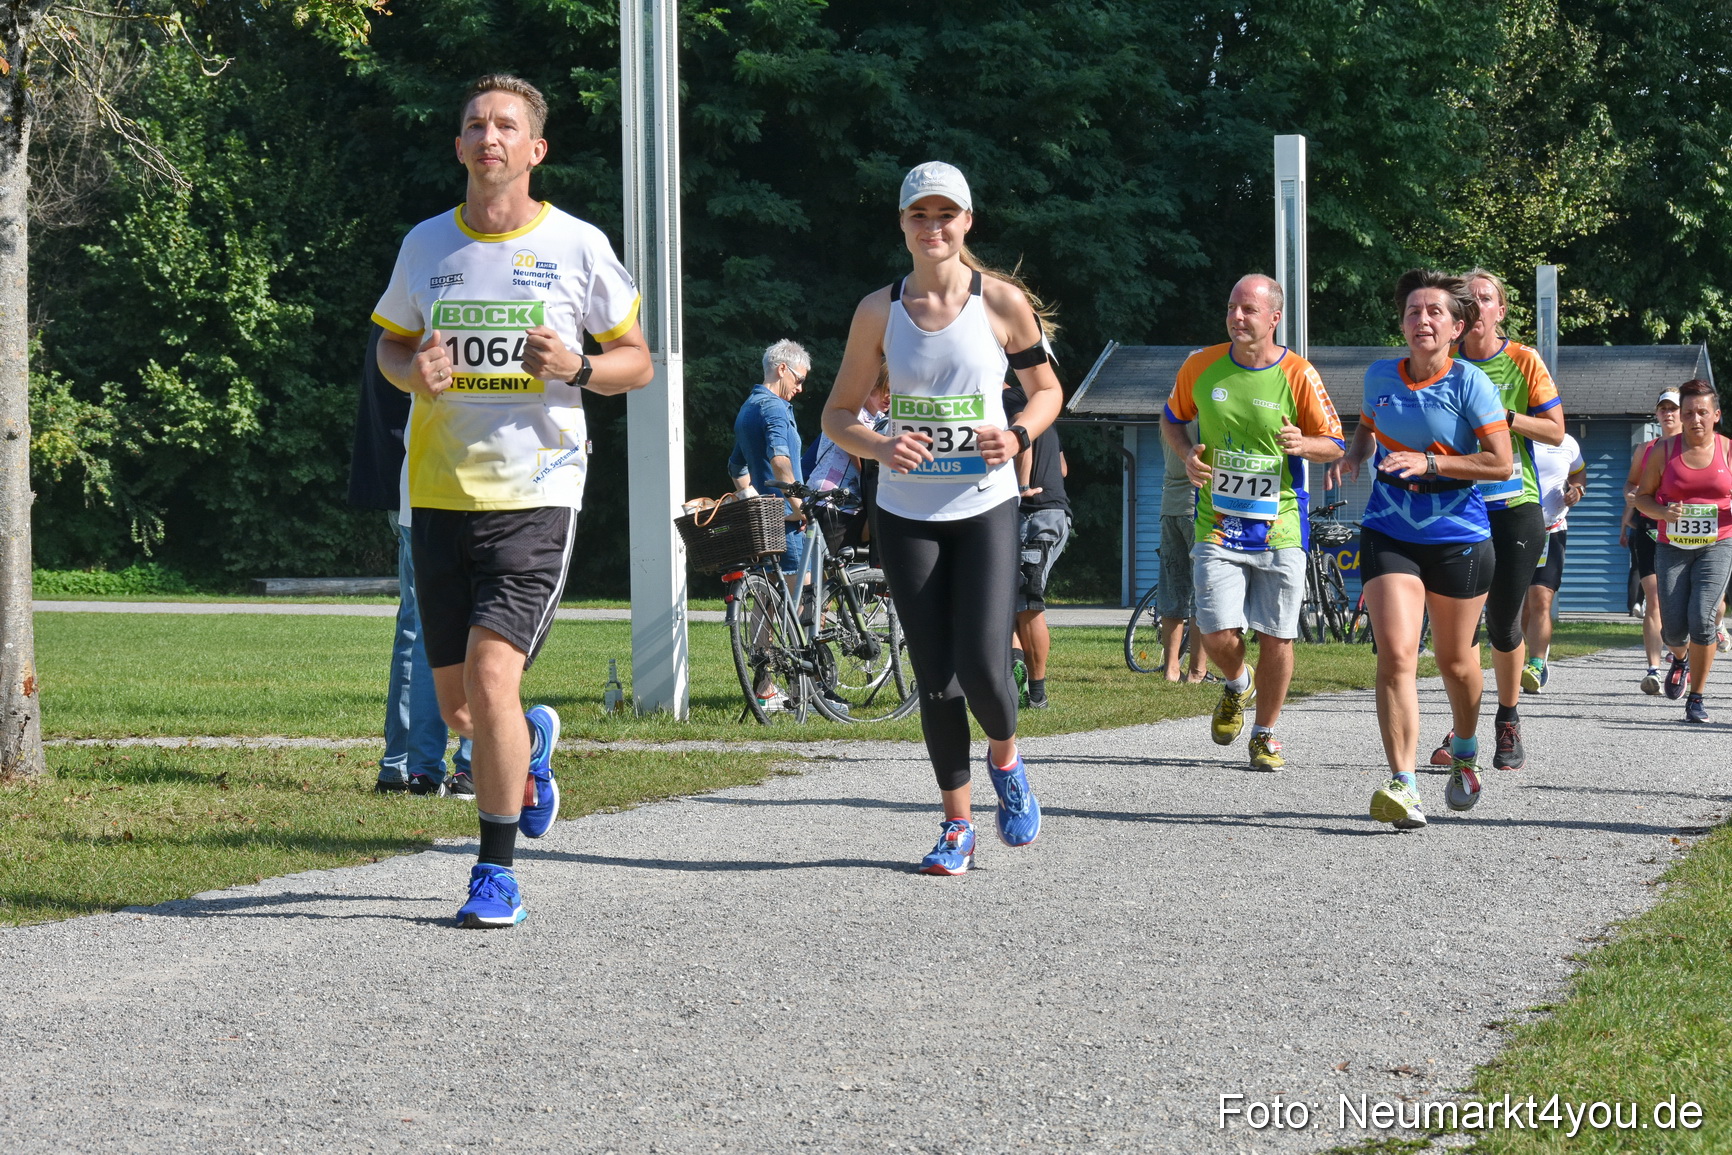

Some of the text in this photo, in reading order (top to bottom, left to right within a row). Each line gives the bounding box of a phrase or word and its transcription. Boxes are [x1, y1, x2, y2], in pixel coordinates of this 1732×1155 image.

[514, 253, 557, 270] 20 JAHRE
[431, 273, 464, 286] BOCK
[513, 269, 562, 280] Neumarkter
[512, 278, 552, 290] Stadtlauf
[441, 305, 530, 325] BOCK
[899, 401, 973, 416] BOCK
[1254, 399, 1280, 409] BOCK
[1219, 455, 1273, 471] BOCK
[1217, 473, 1272, 497] 2712
[1681, 508, 1711, 516] OCK
[1675, 520, 1711, 534] 1333
